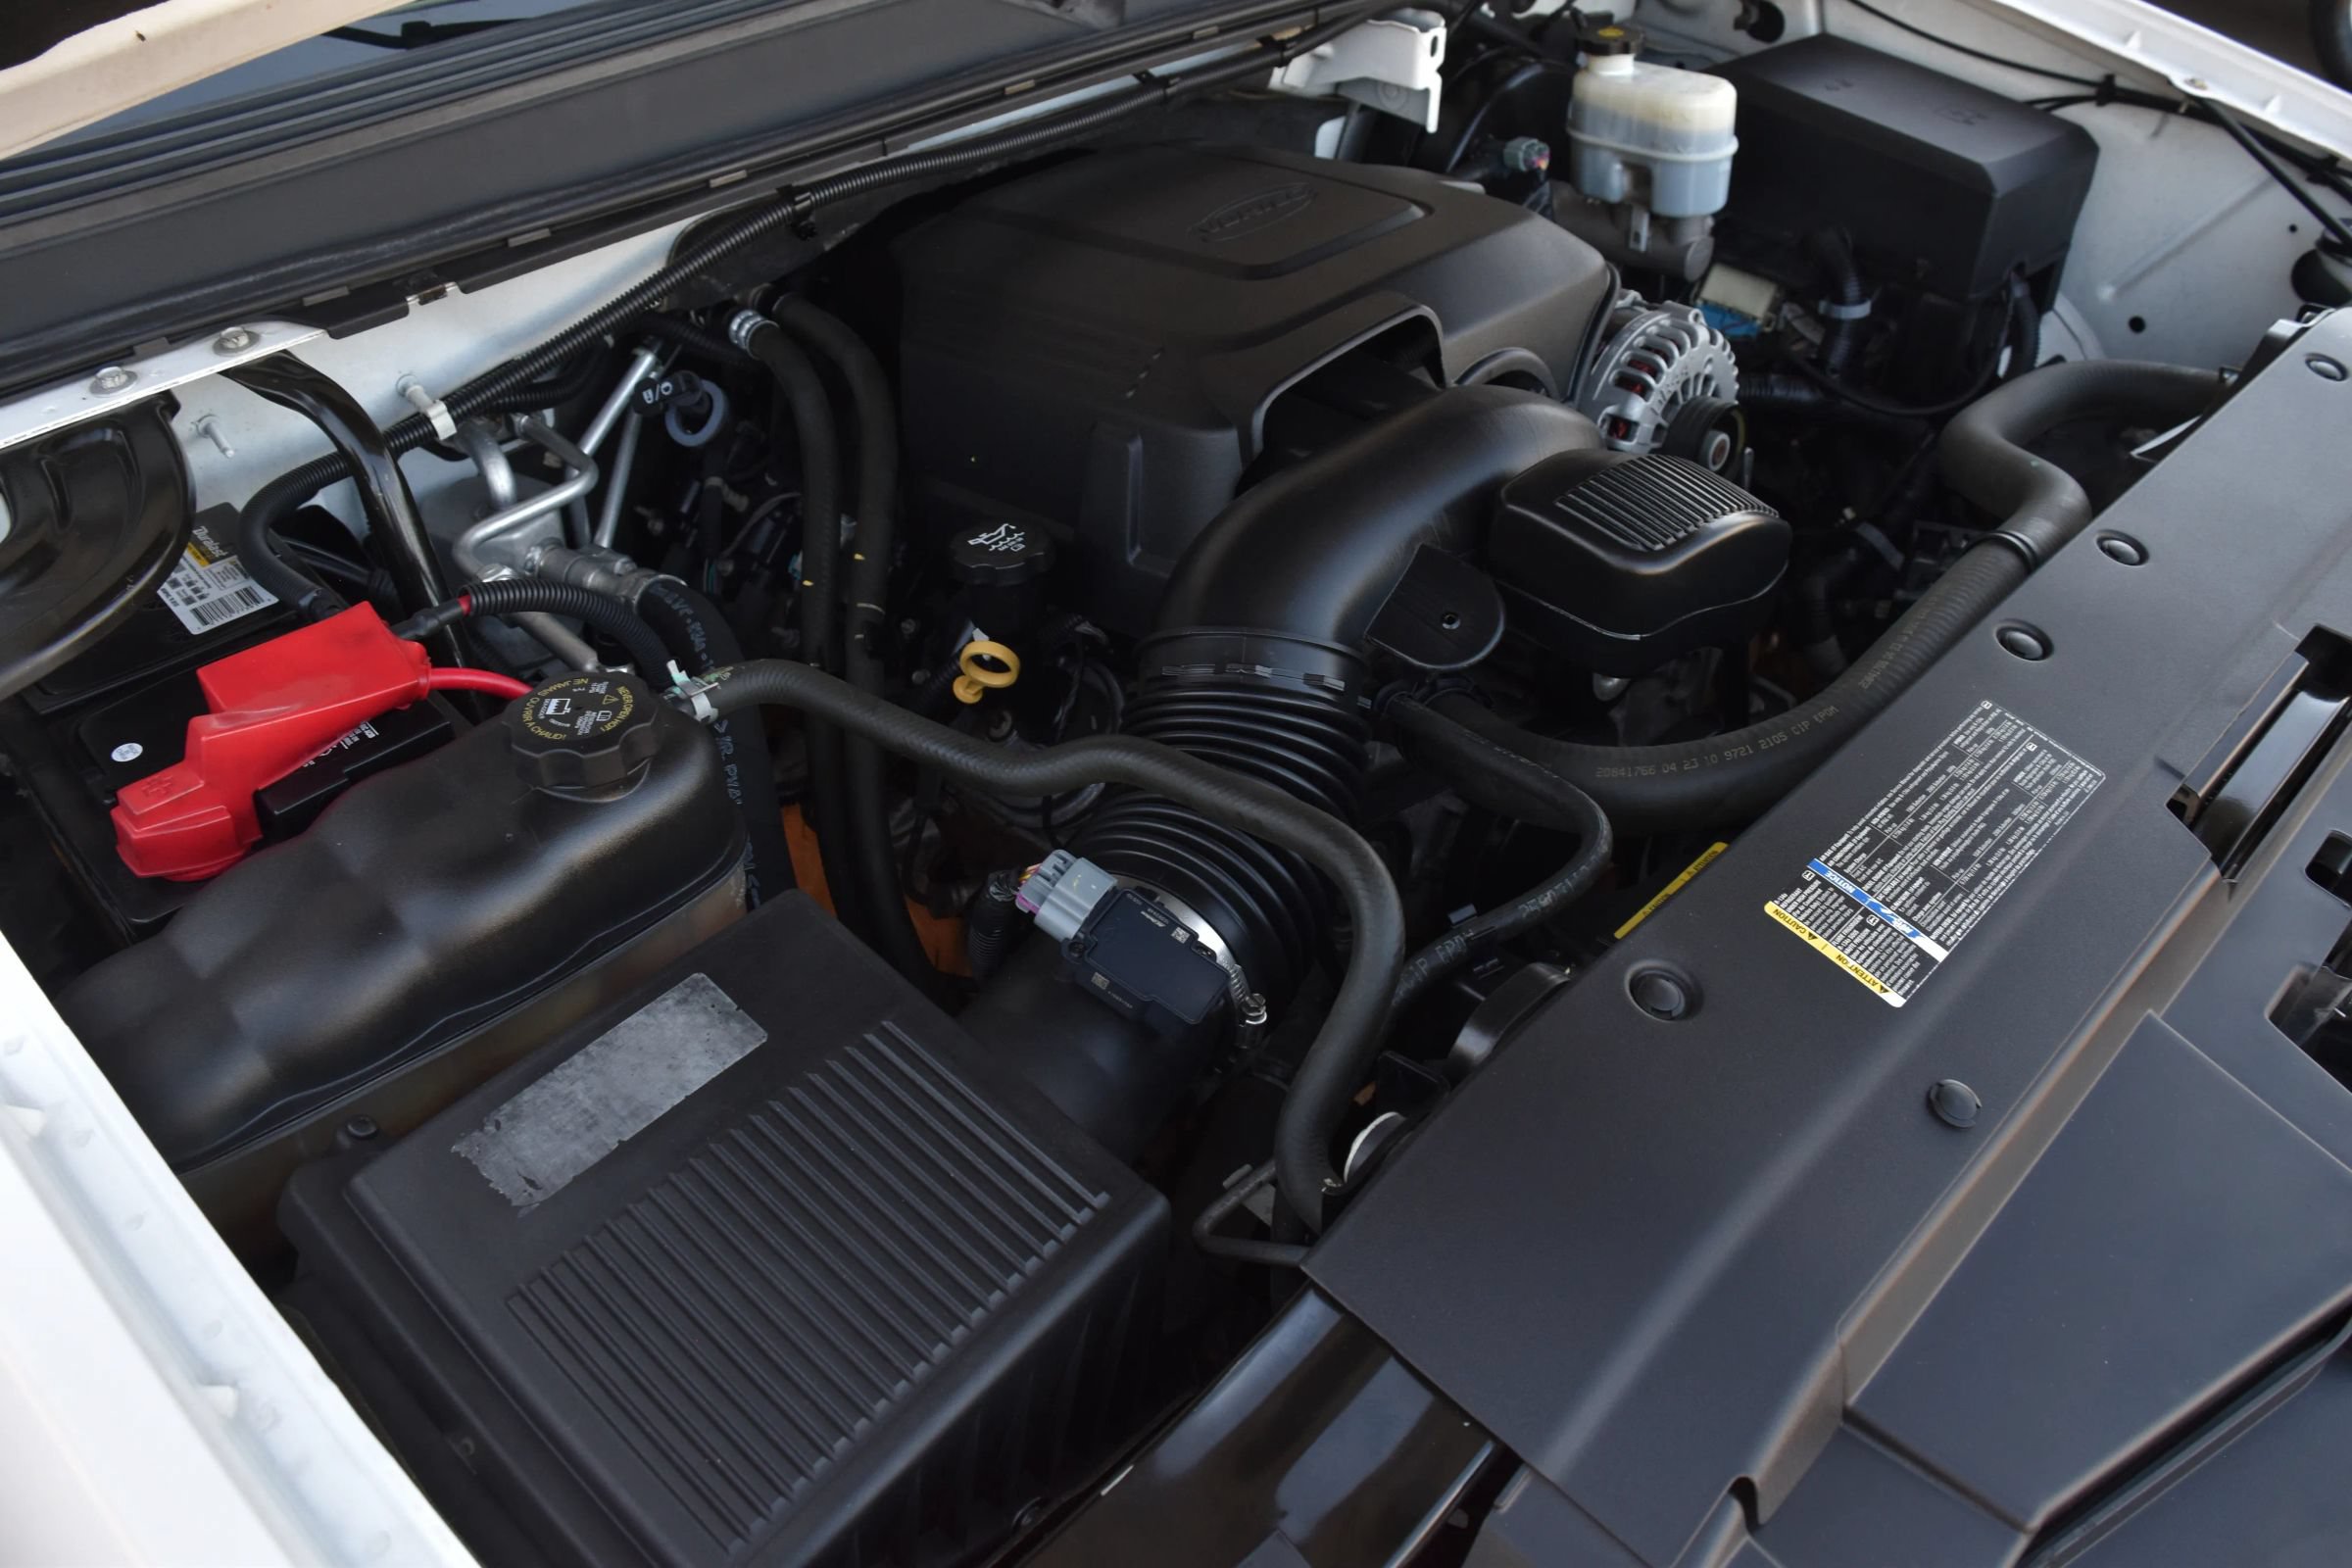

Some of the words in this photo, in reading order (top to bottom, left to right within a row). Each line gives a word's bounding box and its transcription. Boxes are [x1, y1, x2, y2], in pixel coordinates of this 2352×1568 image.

[191, 525, 228, 558] Duralast
[538, 680, 571, 697] JAMAIS
[1662, 761, 1677, 773] 04
[1684, 758, 1699, 771] 23
[1725, 746, 1753, 761] 9721
[1759, 731, 1788, 750] 2105
[1824, 868, 1855, 894] NOTICE
[1772, 907, 1808, 936] CAUTION
